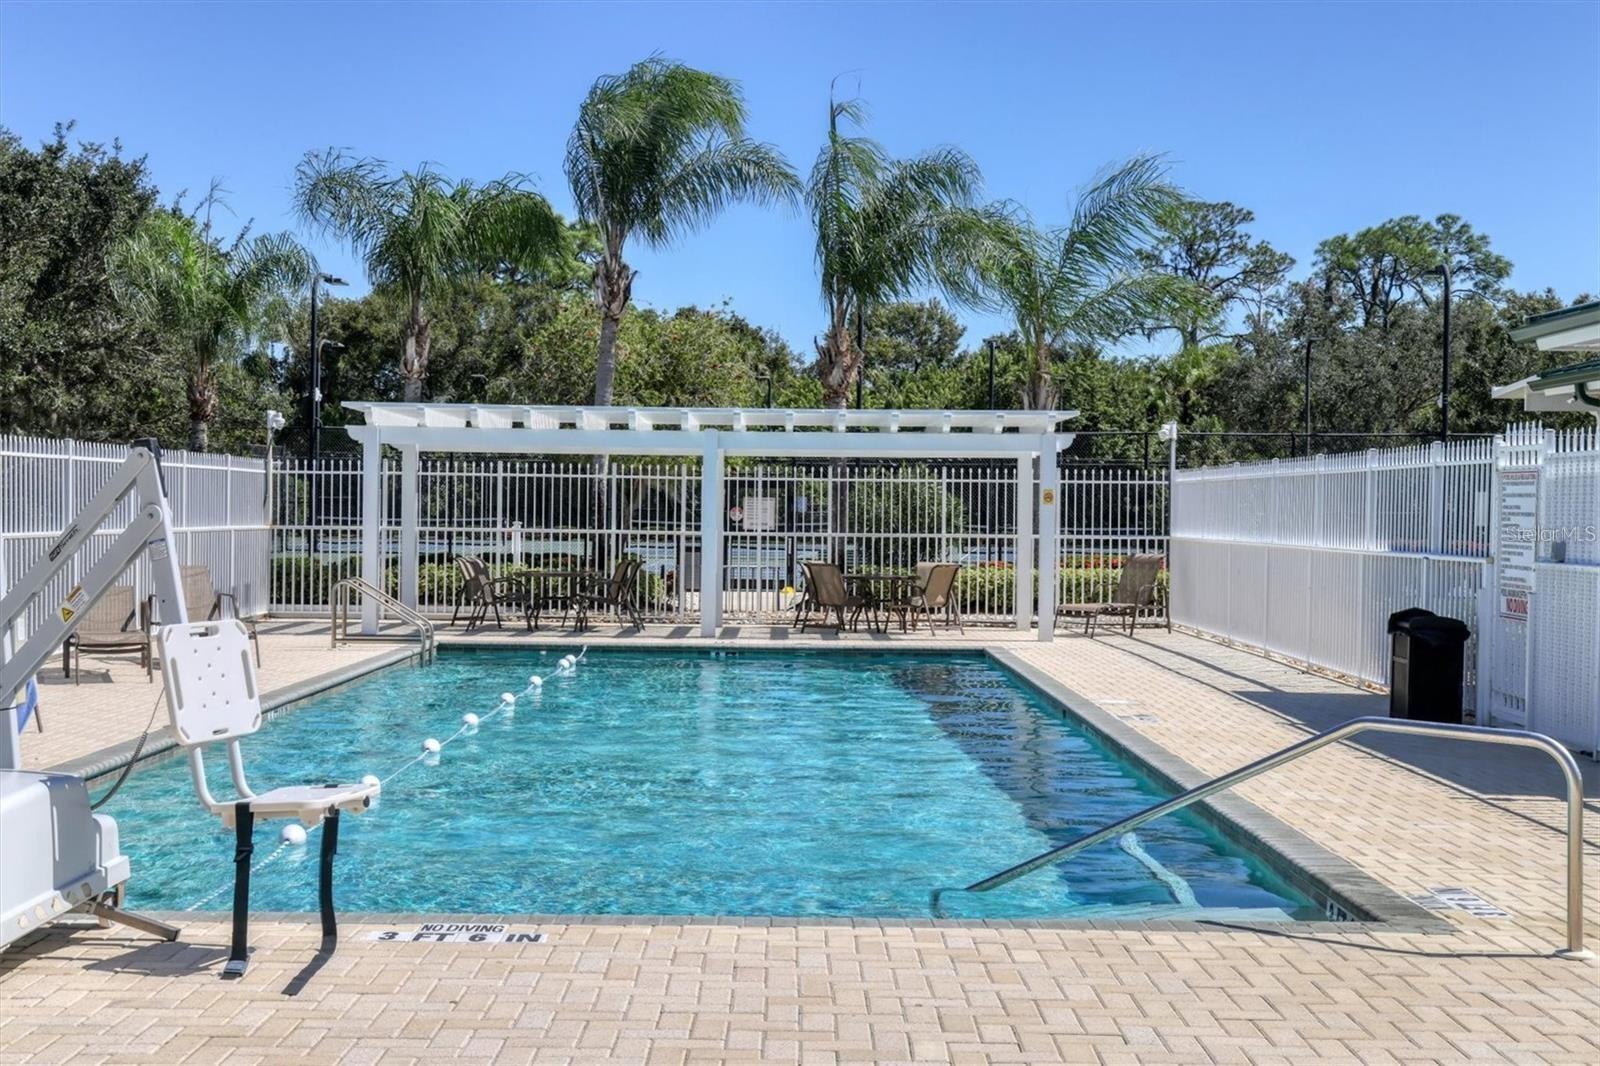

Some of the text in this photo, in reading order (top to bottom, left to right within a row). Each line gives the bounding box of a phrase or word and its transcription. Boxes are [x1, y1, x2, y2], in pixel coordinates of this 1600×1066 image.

[421, 924, 505, 933] NO DIVING
[378, 931, 542, 943] 3 FT 6 IN
